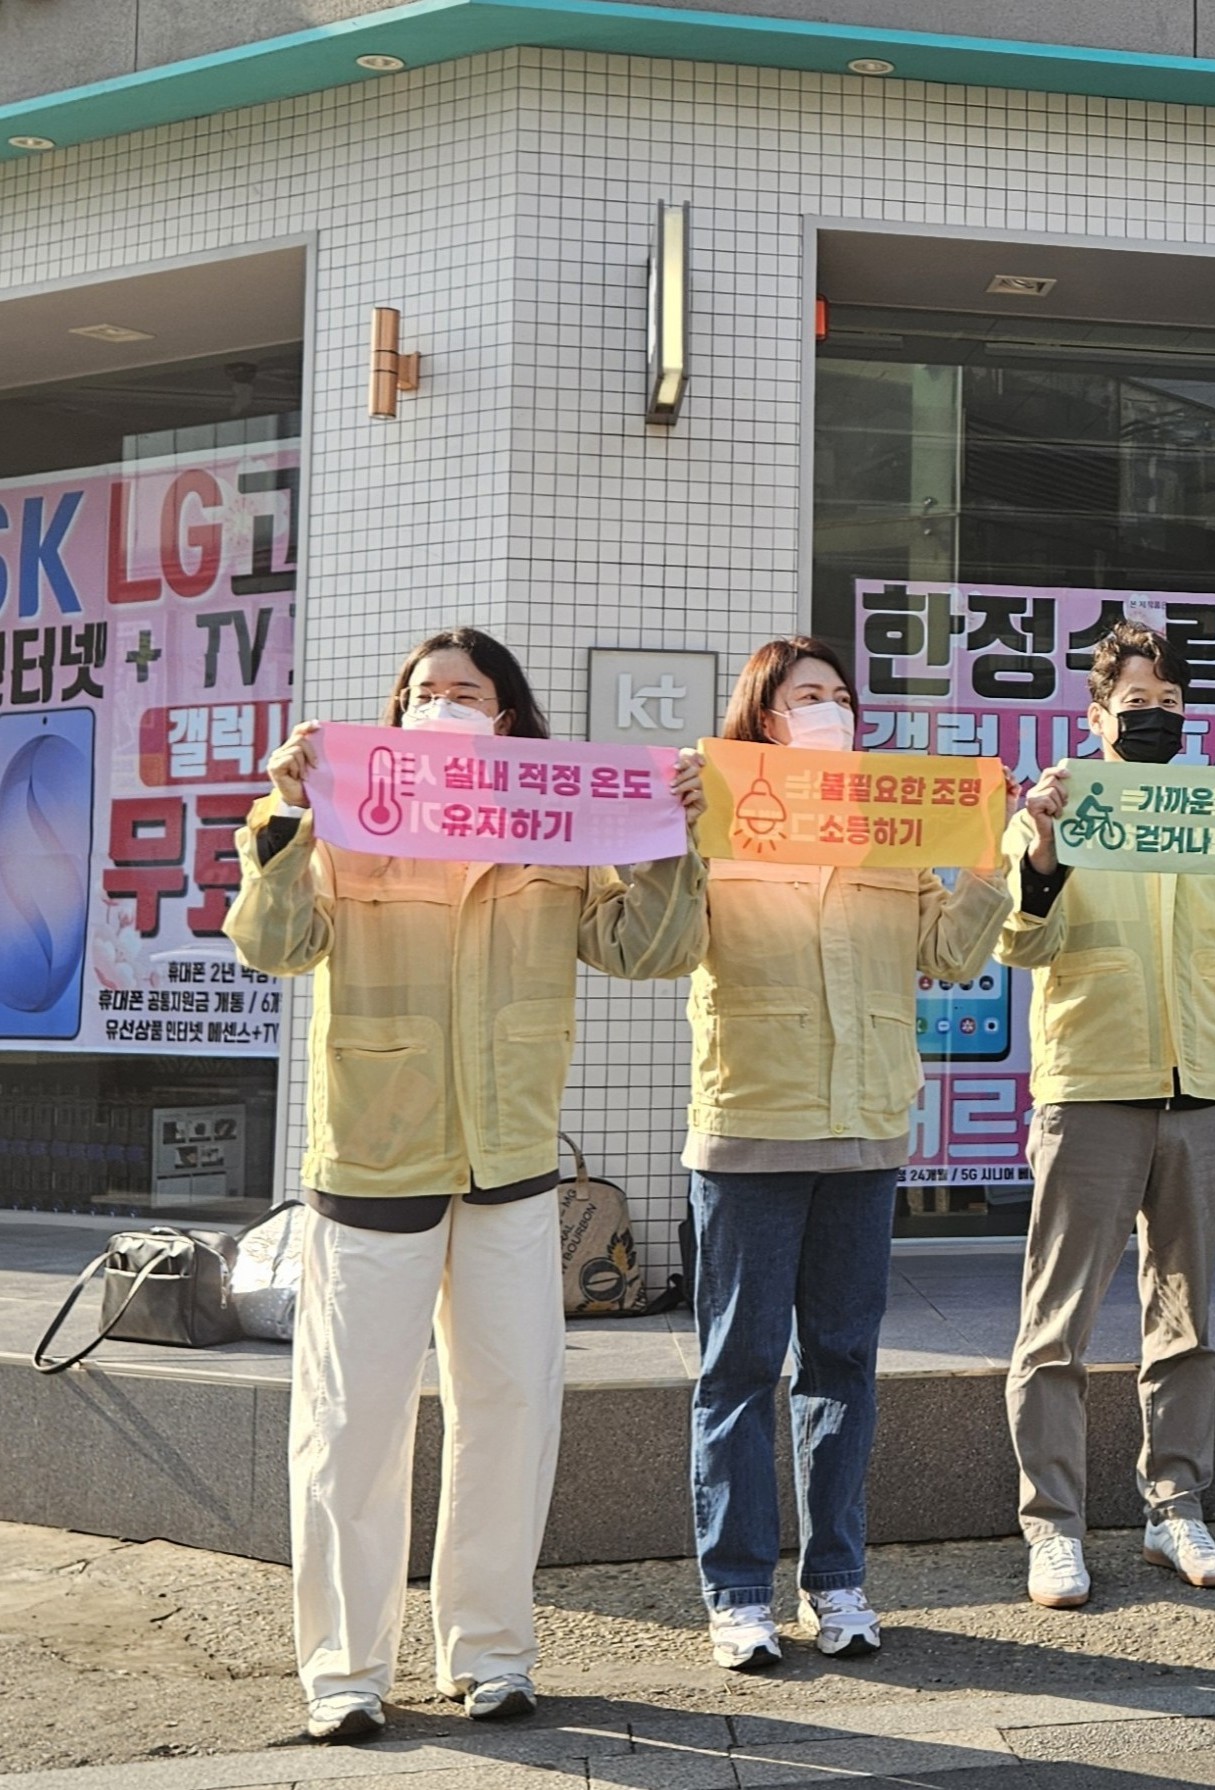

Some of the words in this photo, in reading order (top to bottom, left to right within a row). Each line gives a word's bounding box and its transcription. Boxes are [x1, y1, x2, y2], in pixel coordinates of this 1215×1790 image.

[0, 490, 85, 619] K
[0, 621, 108, 704] 터넷
[196, 607, 274, 688] TV
[617, 673, 687, 730] kt
[444, 756, 509, 792] 실내
[518, 761, 581, 796] 적정
[590, 766, 652, 799] 온도
[820, 771, 925, 805] 불필요한
[931, 777, 981, 806] 조명
[1137, 785, 1214, 815] 가까운
[442, 803, 573, 842] 유지하기
[819, 815, 922, 847] 소등하기
[1136, 825, 1211, 854] 걷거나
[168, 960, 206, 983] 휴대폰
[210, 963, 236, 983] 2년
[98, 989, 144, 1012] 휴대폰
[215, 991, 245, 1013] 개통
[106, 1019, 163, 1041] 유선상품
[166, 1021, 203, 1043] 인터넷
[961, 1168, 978, 1180] 5G
[563, 1203, 597, 1261] BOURBON
